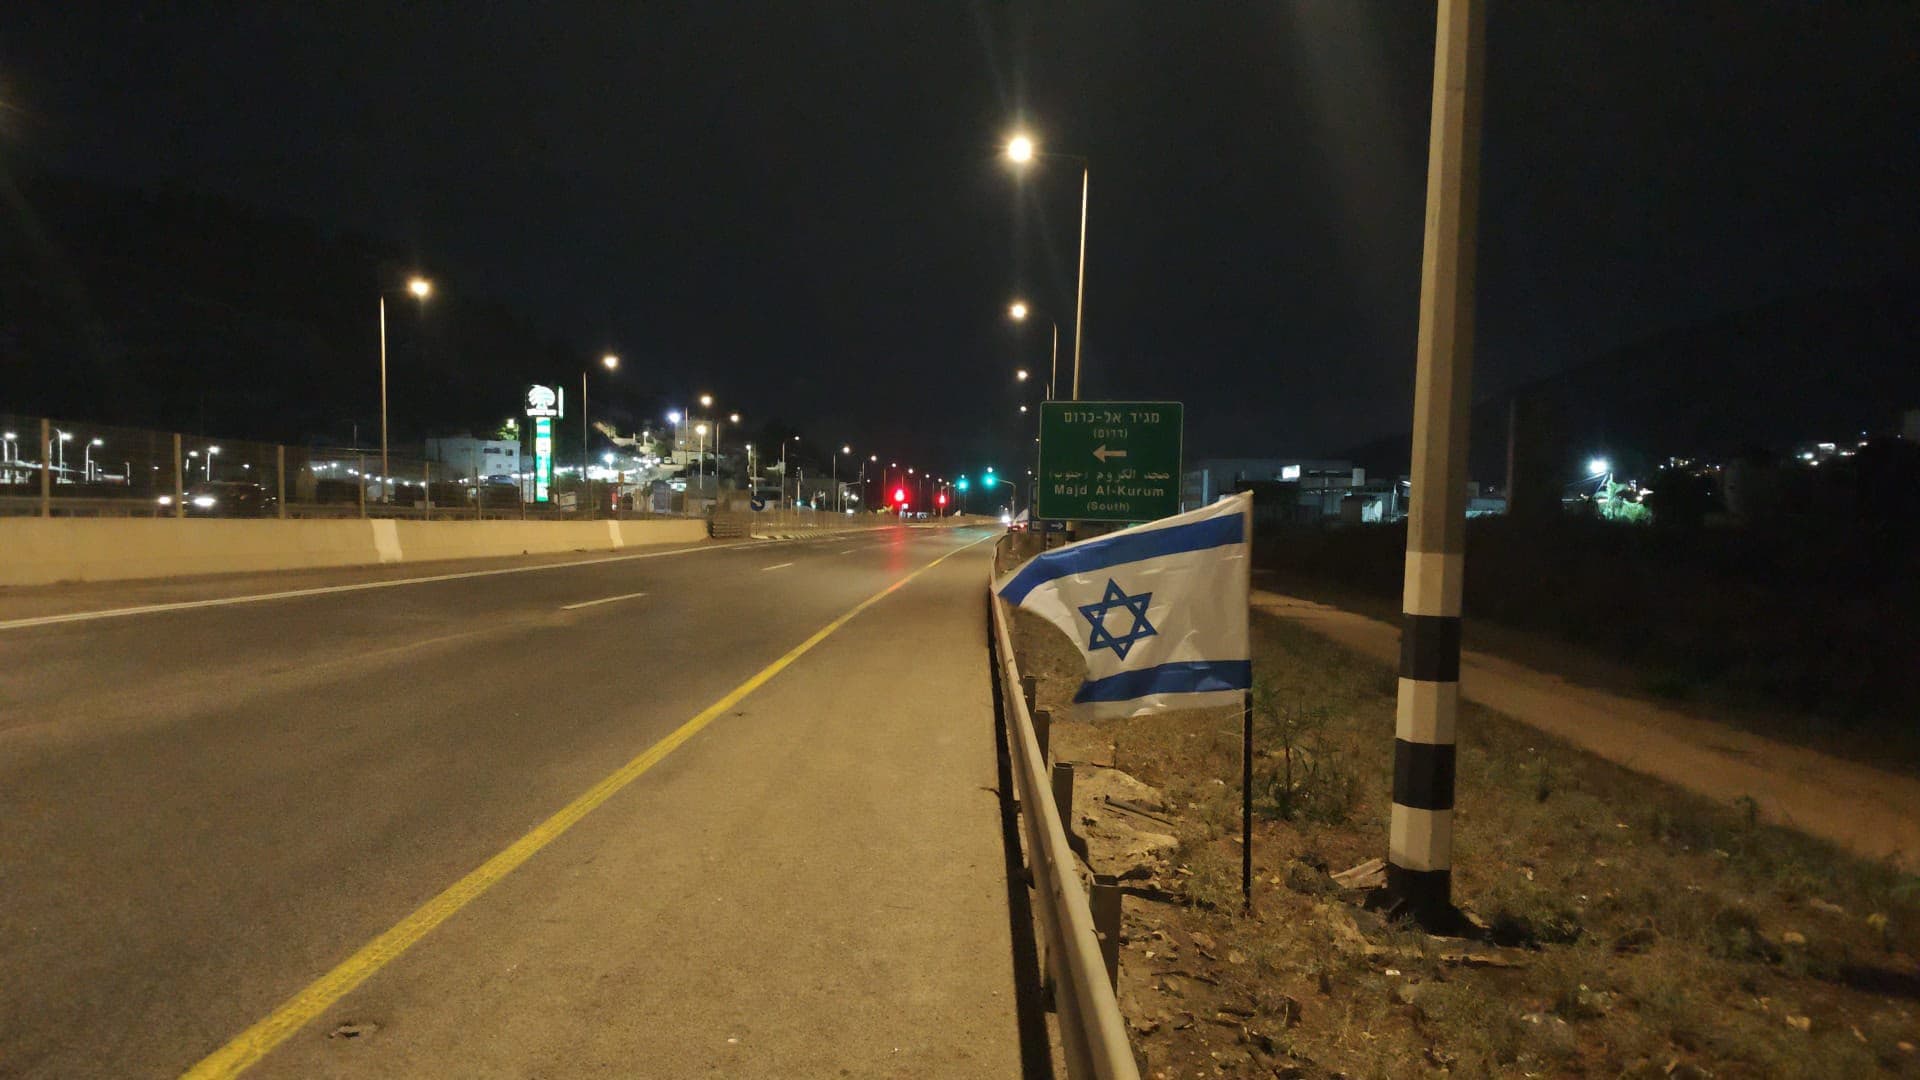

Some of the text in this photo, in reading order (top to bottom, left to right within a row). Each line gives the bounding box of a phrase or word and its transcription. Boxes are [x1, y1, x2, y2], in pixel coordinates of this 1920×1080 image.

[1064, 411, 1160, 424] מגיד אל-כרום
[1093, 428, 1128, 439] (דרום)
[1054, 484, 1164, 498] Majd Al-Kurum
[1086, 501, 1130, 512] (South)
